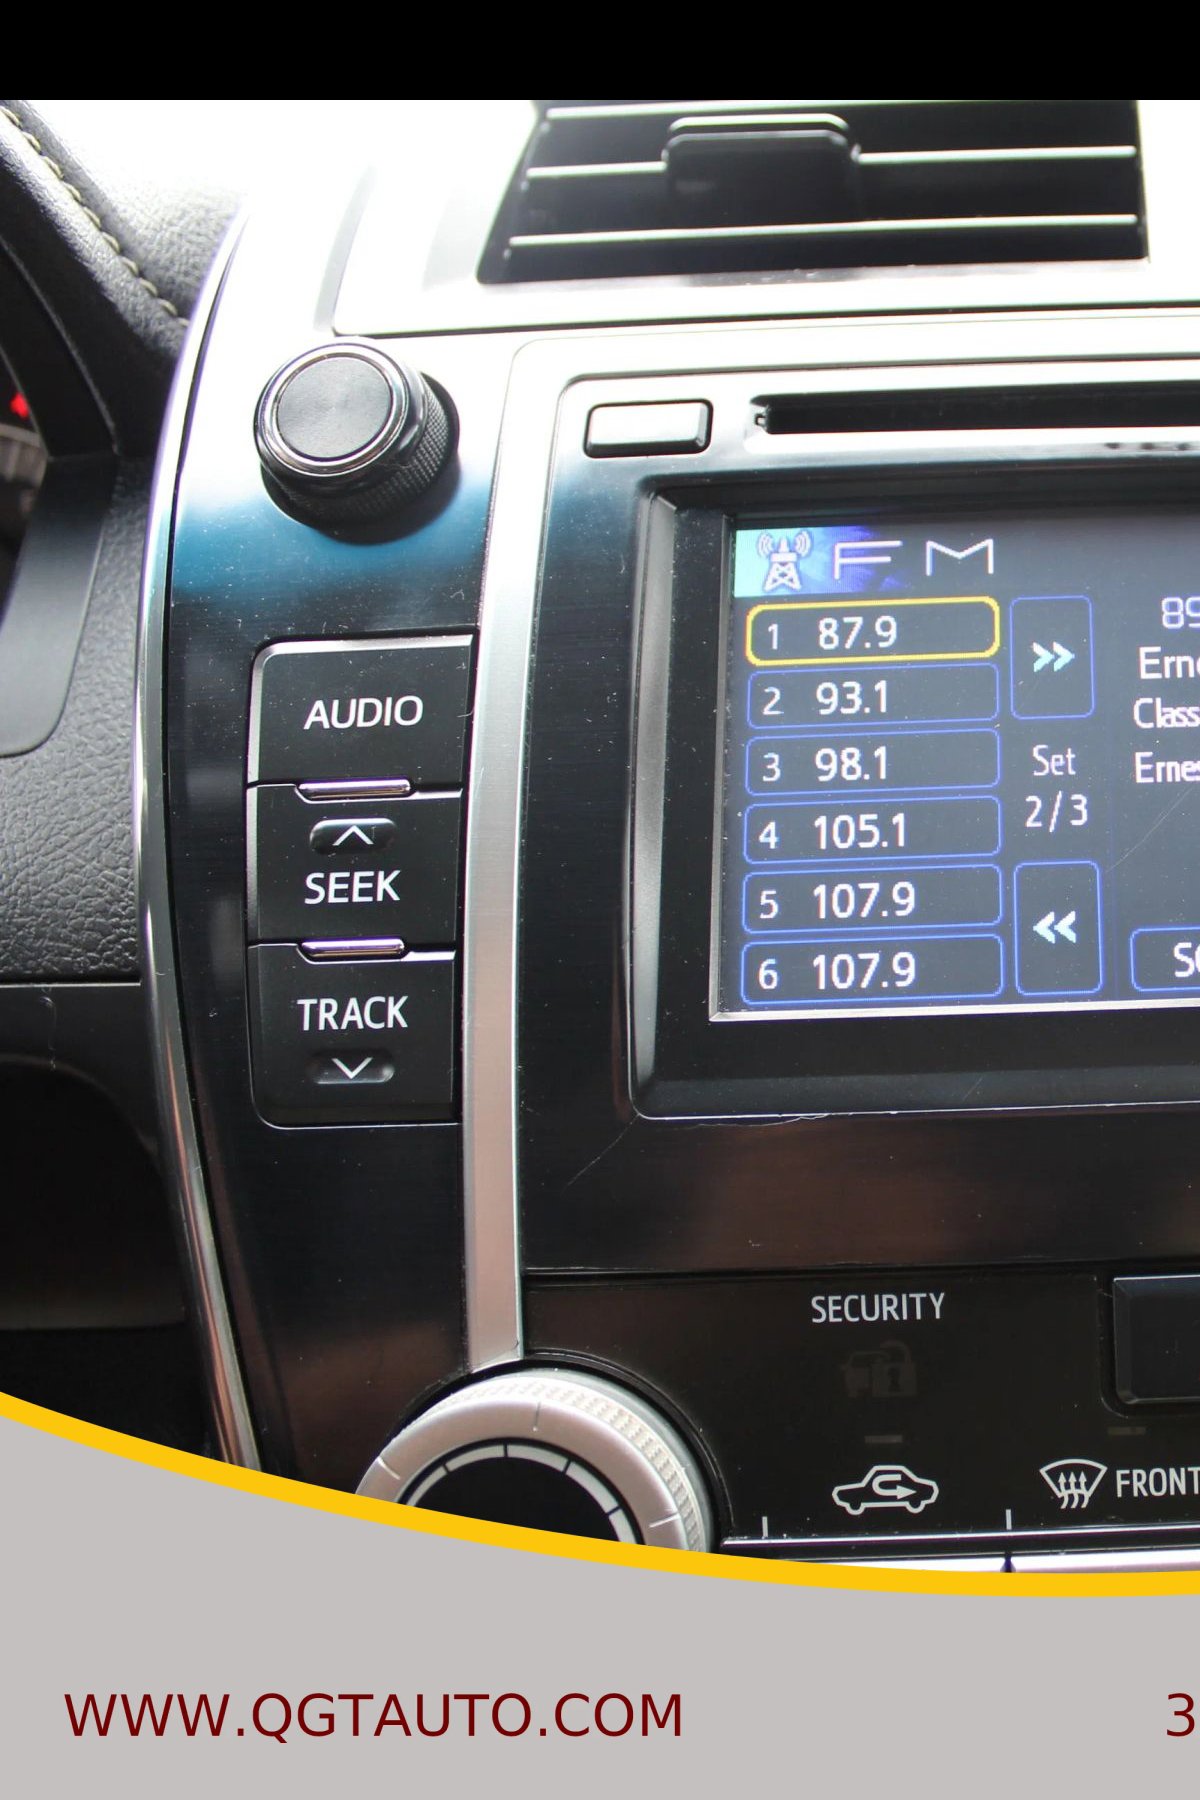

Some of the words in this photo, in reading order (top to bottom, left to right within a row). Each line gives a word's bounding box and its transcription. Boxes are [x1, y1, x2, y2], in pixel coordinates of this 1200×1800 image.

[833, 538, 994, 581] FM
[767, 622, 779, 651] 1
[818, 614, 898, 651] 87.9
[303, 695, 423, 730] AUDIO
[762, 687, 783, 716] 2
[815, 680, 889, 716] 93.1
[762, 752, 781, 782] 3
[814, 746, 888, 782] 98.1
[1032, 744, 1077, 777] Set
[1025, 791, 1088, 833] 2/3
[758, 820, 780, 850] 4
[814, 812, 907, 850] 105.1
[304, 870, 401, 905] SEEK
[759, 890, 780, 920] 5
[813, 881, 916, 920] 107.9
[758, 959, 779, 989] 6
[813, 951, 917, 990] 107.9
[297, 996, 409, 1031] TRACK
[810, 1292, 946, 1325] SECURITY
